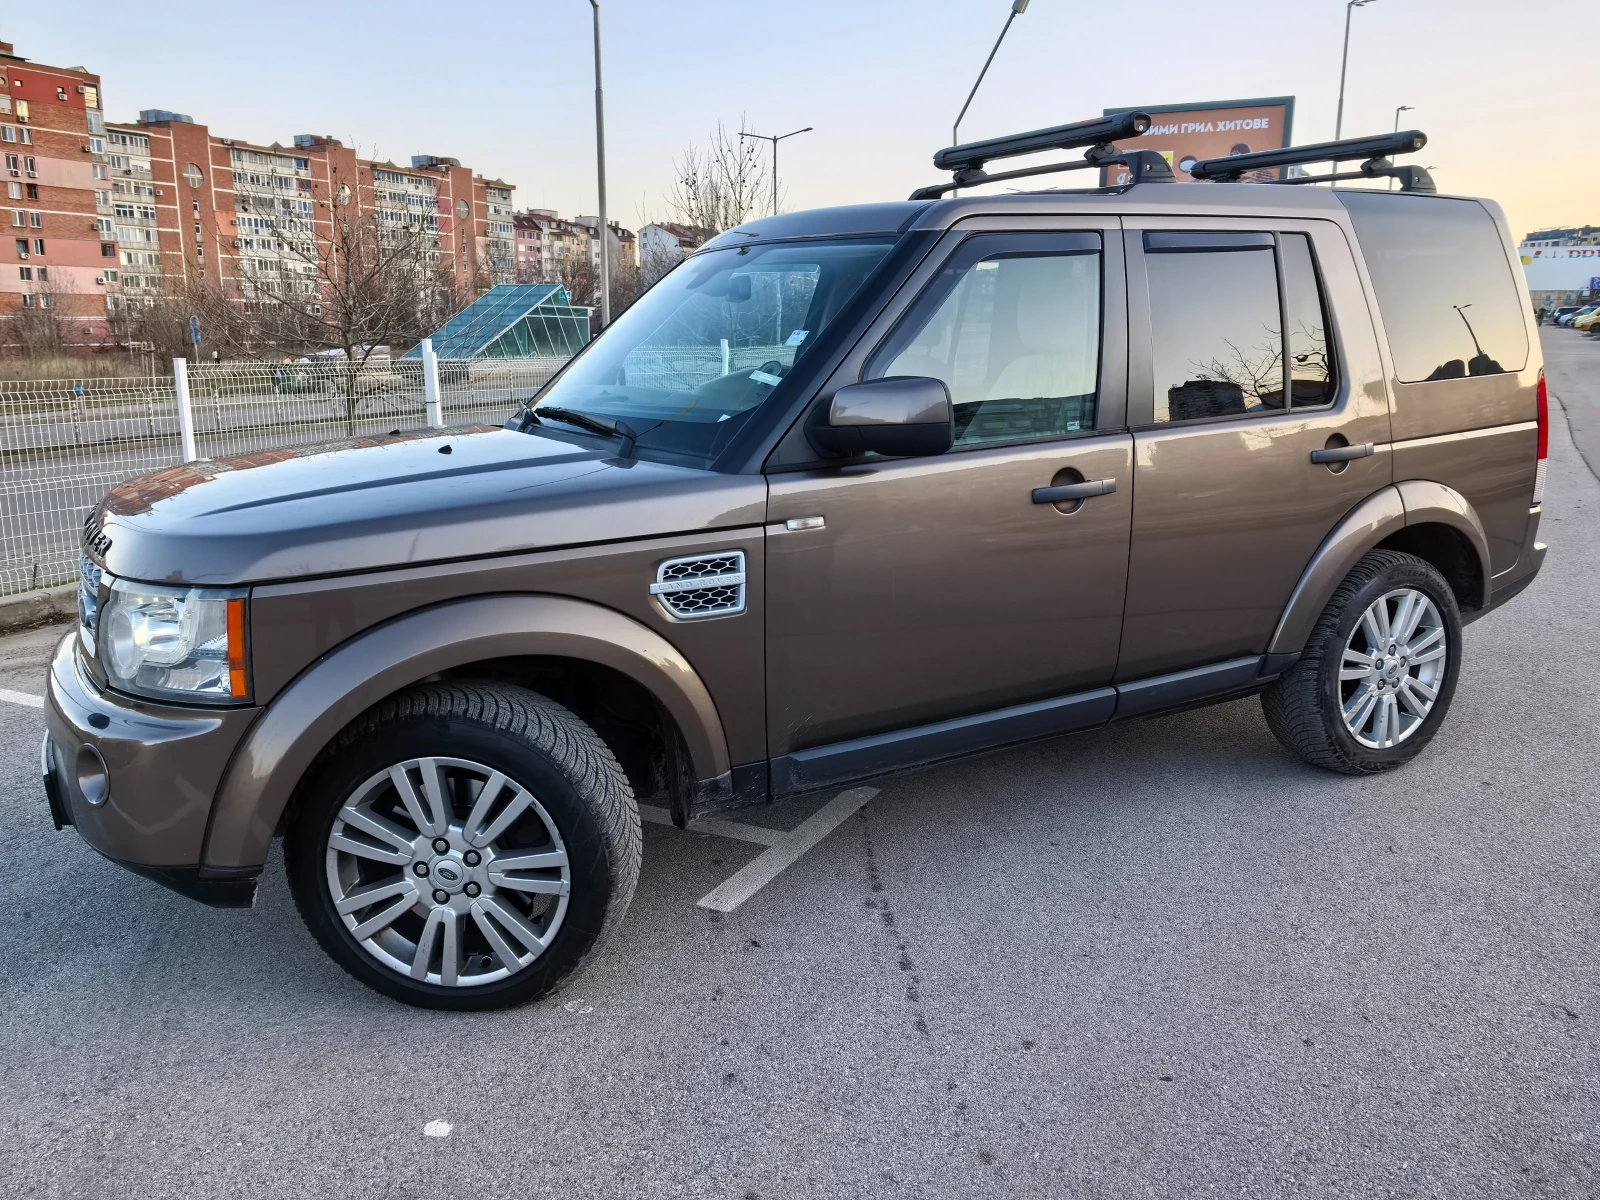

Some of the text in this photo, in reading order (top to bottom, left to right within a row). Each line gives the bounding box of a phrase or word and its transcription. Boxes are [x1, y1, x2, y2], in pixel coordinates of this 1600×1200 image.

[1180, 121, 1214, 134] ГРИЛ
[1216, 118, 1269, 132] ХИТОВЕ
[658, 575, 741, 591] LAND ROVER
